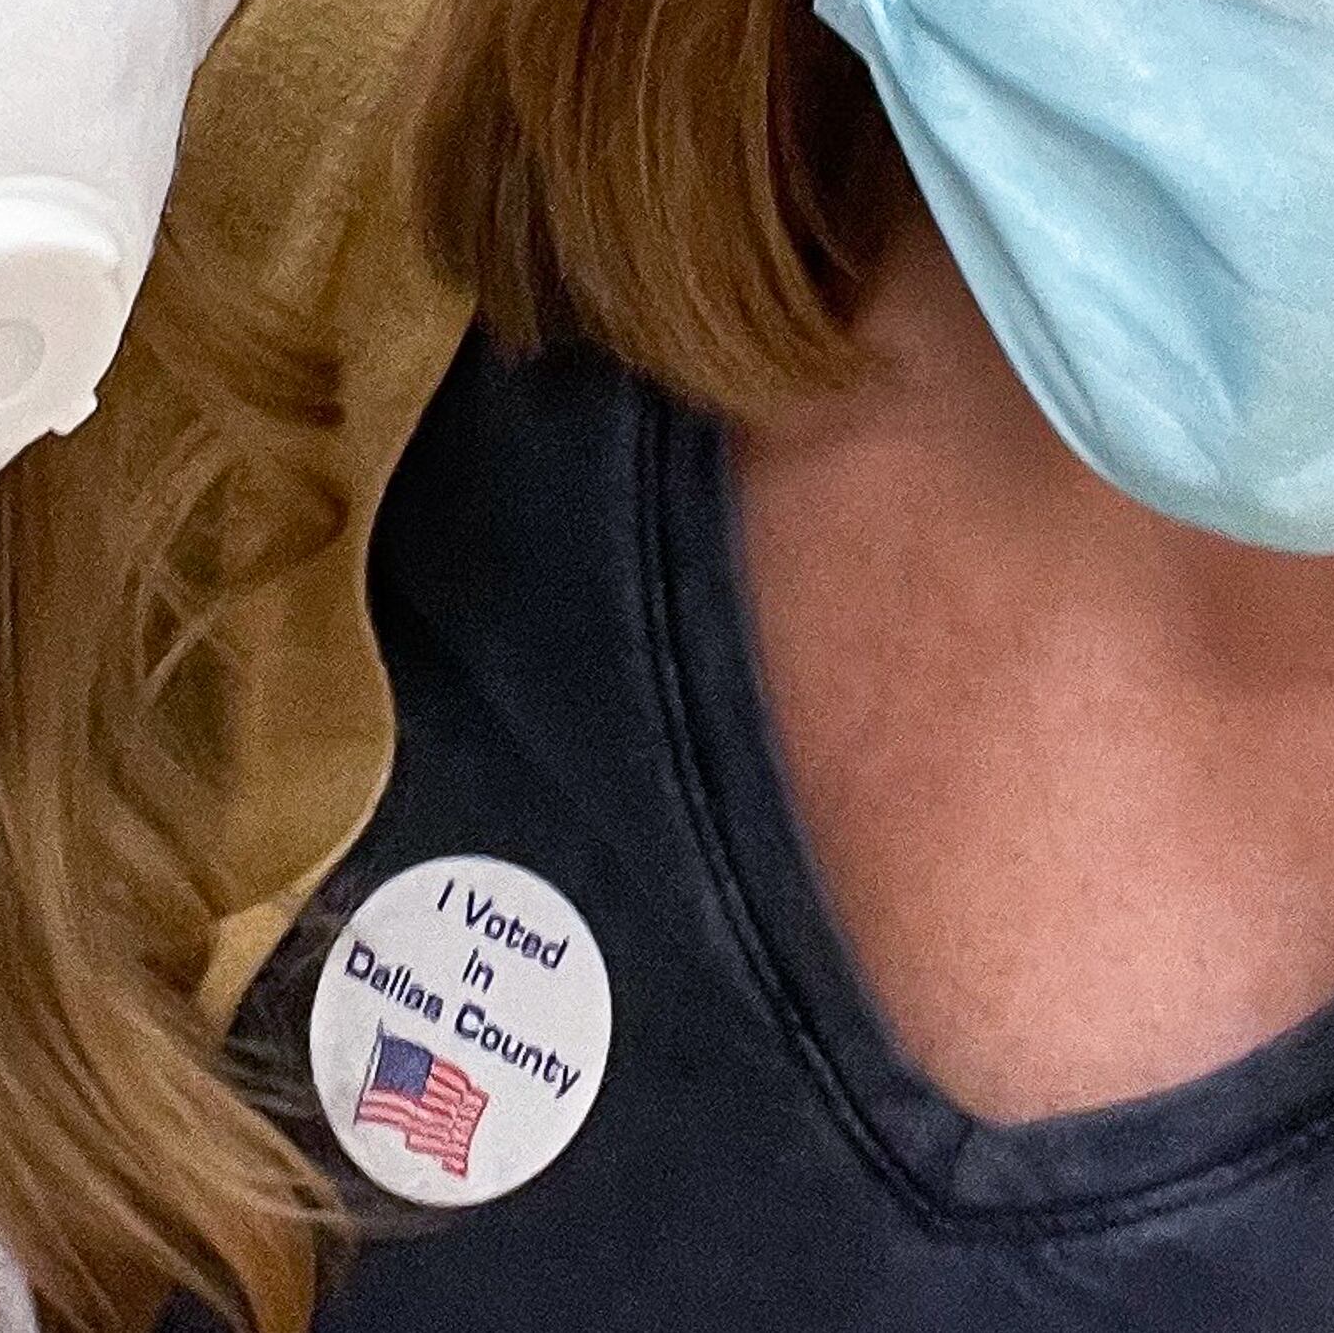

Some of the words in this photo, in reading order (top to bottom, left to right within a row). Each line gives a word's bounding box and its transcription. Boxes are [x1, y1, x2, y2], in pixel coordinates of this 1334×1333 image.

[436, 878, 454, 912] I
[465, 889, 569, 970] Voted
[344, 939, 444, 1024] Dallas
[455, 1001, 582, 1099] County
